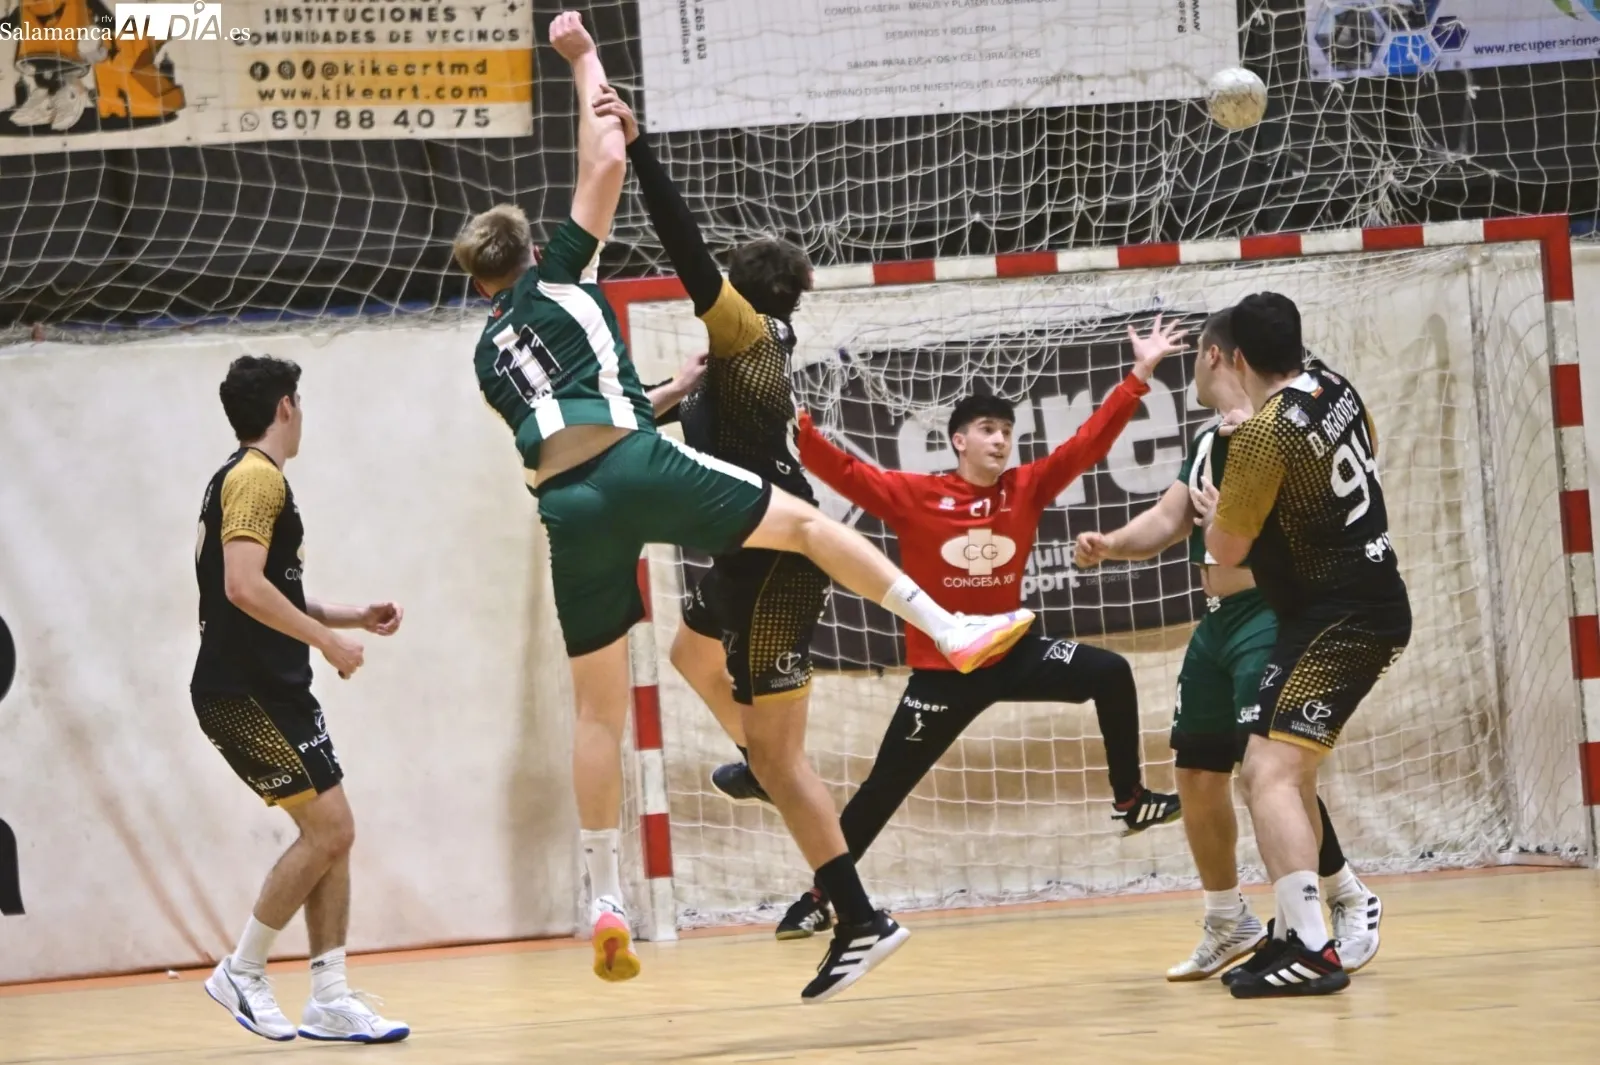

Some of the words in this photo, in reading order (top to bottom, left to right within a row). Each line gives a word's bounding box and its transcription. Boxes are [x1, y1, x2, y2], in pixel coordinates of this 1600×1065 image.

[263, 6, 457, 25] INSTITUCIONES
[473, 6, 487, 21] Y
[389, 28, 413, 43] DE
[427, 27, 520, 43] VECINOS
[258, 84, 488, 101] www.kikeart.com
[271, 109, 321, 130] 607
[334, 108, 375, 129] 88
[393, 108, 435, 128] 40
[452, 107, 490, 127] 75
[963, 543, 998, 561] CG
[943, 576, 1001, 588] CONGESA
